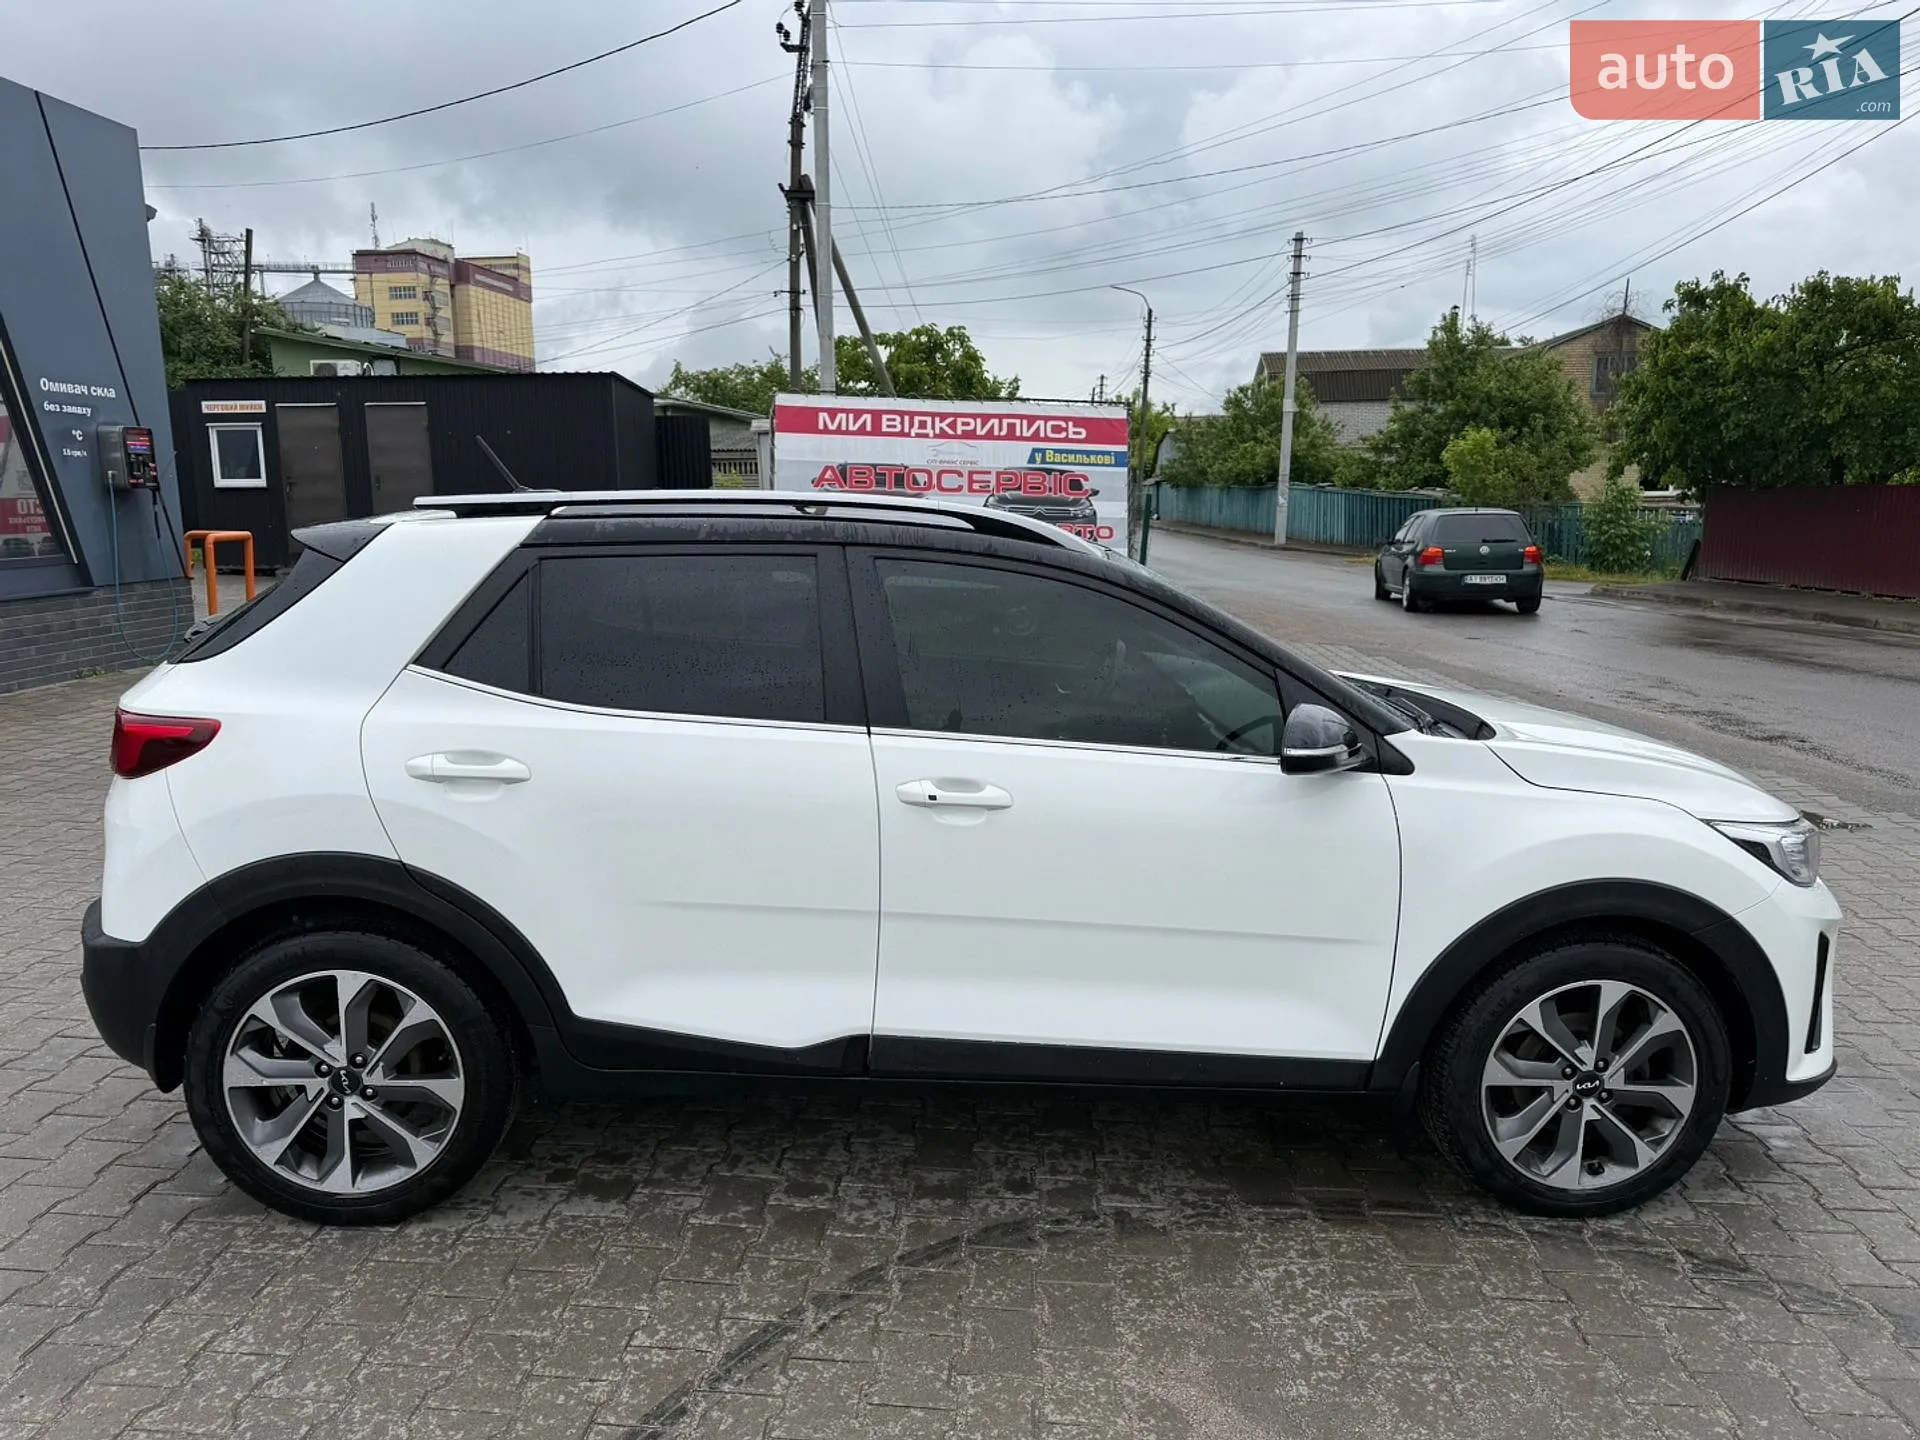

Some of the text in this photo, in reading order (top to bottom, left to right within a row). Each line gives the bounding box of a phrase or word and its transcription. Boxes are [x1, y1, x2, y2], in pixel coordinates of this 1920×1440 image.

[40, 377, 116, 398] Омивач скла
[43, 400, 92, 417] без запаху
[817, 412, 1088, 439] МИ ВІДКРИЛИСЬ
[1035, 450, 1116, 465] у Василькові
[814, 465, 1091, 498] АВТОСЕРВІС
